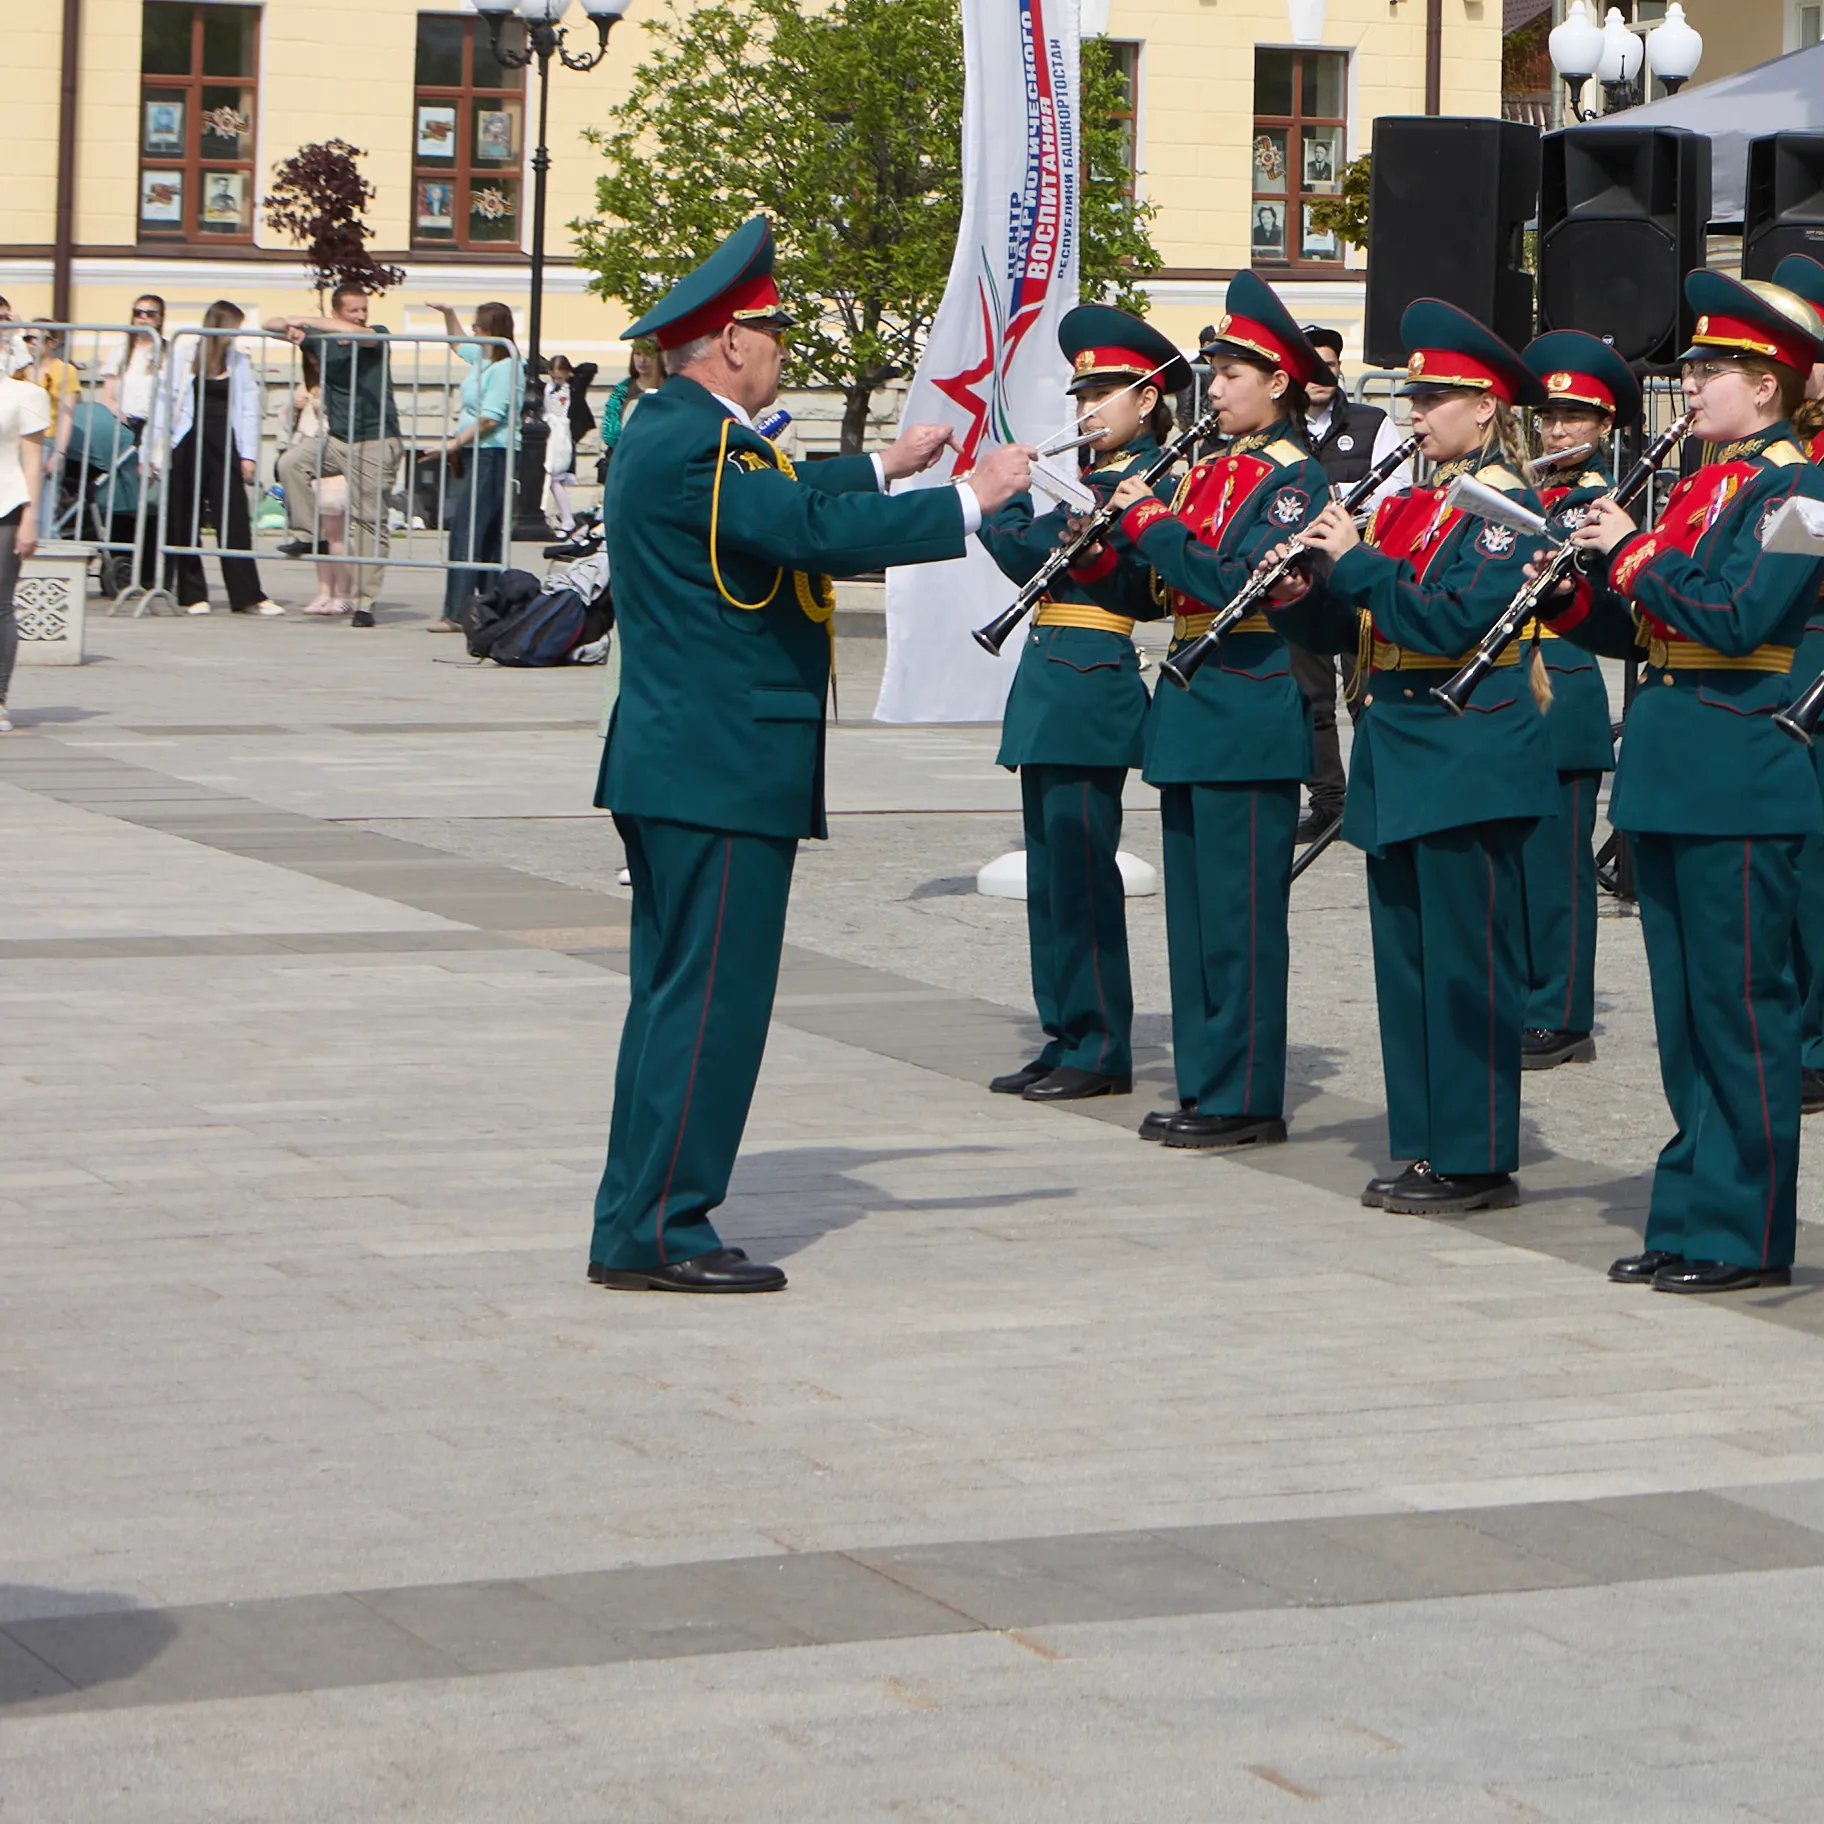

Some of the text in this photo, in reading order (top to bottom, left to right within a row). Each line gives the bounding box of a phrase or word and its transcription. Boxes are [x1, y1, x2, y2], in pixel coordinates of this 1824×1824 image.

[1007, 191, 1021, 281] ЦЕНТР
[1015, 10, 1041, 280] ПАТРИОТИЧЕСКОГО
[1027, 96, 1059, 281] ВОСПИТАНИЯ
[1049, 38, 1074, 280] РЕСПУБЛИКИ БАШКОРТОСТАН
